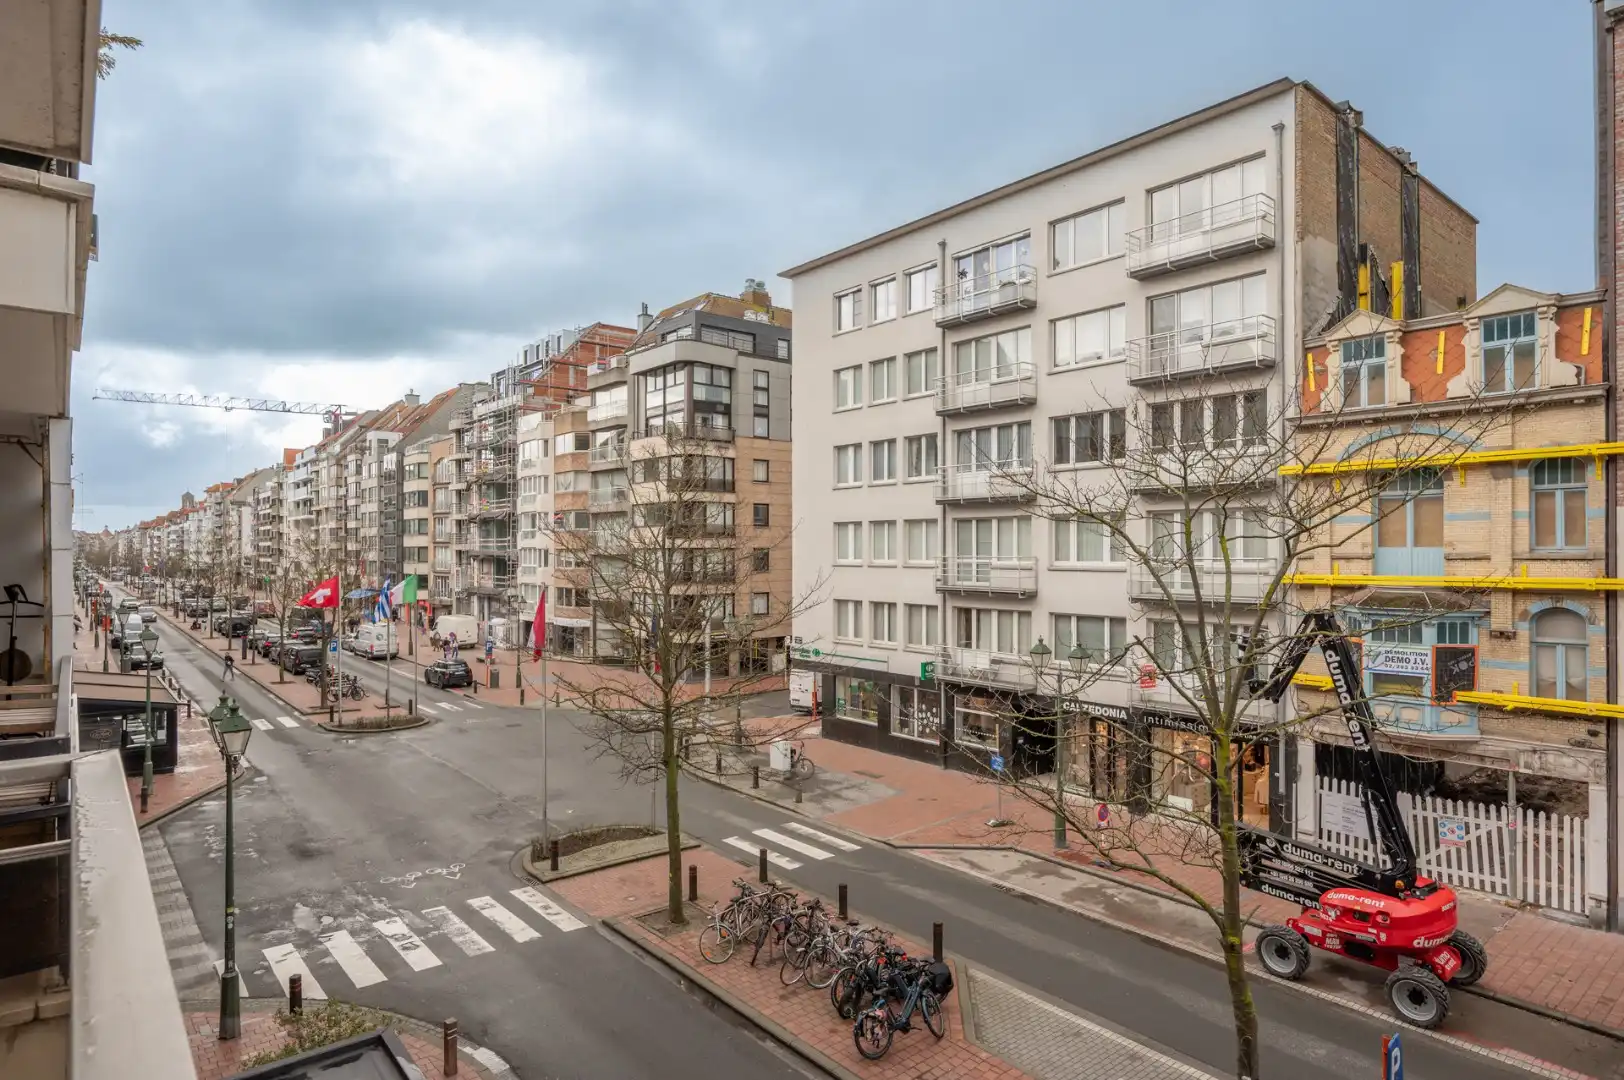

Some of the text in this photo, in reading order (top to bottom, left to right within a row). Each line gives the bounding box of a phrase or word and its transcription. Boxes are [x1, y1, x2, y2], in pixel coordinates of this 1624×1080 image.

[1384, 655, 1429, 666] DEMO J.V.
[1325, 650, 1370, 752] dumarent
[1283, 842, 1361, 876] duma-rent
[1261, 883, 1322, 911] duma-ren
[1327, 891, 1385, 909] duma-rent
